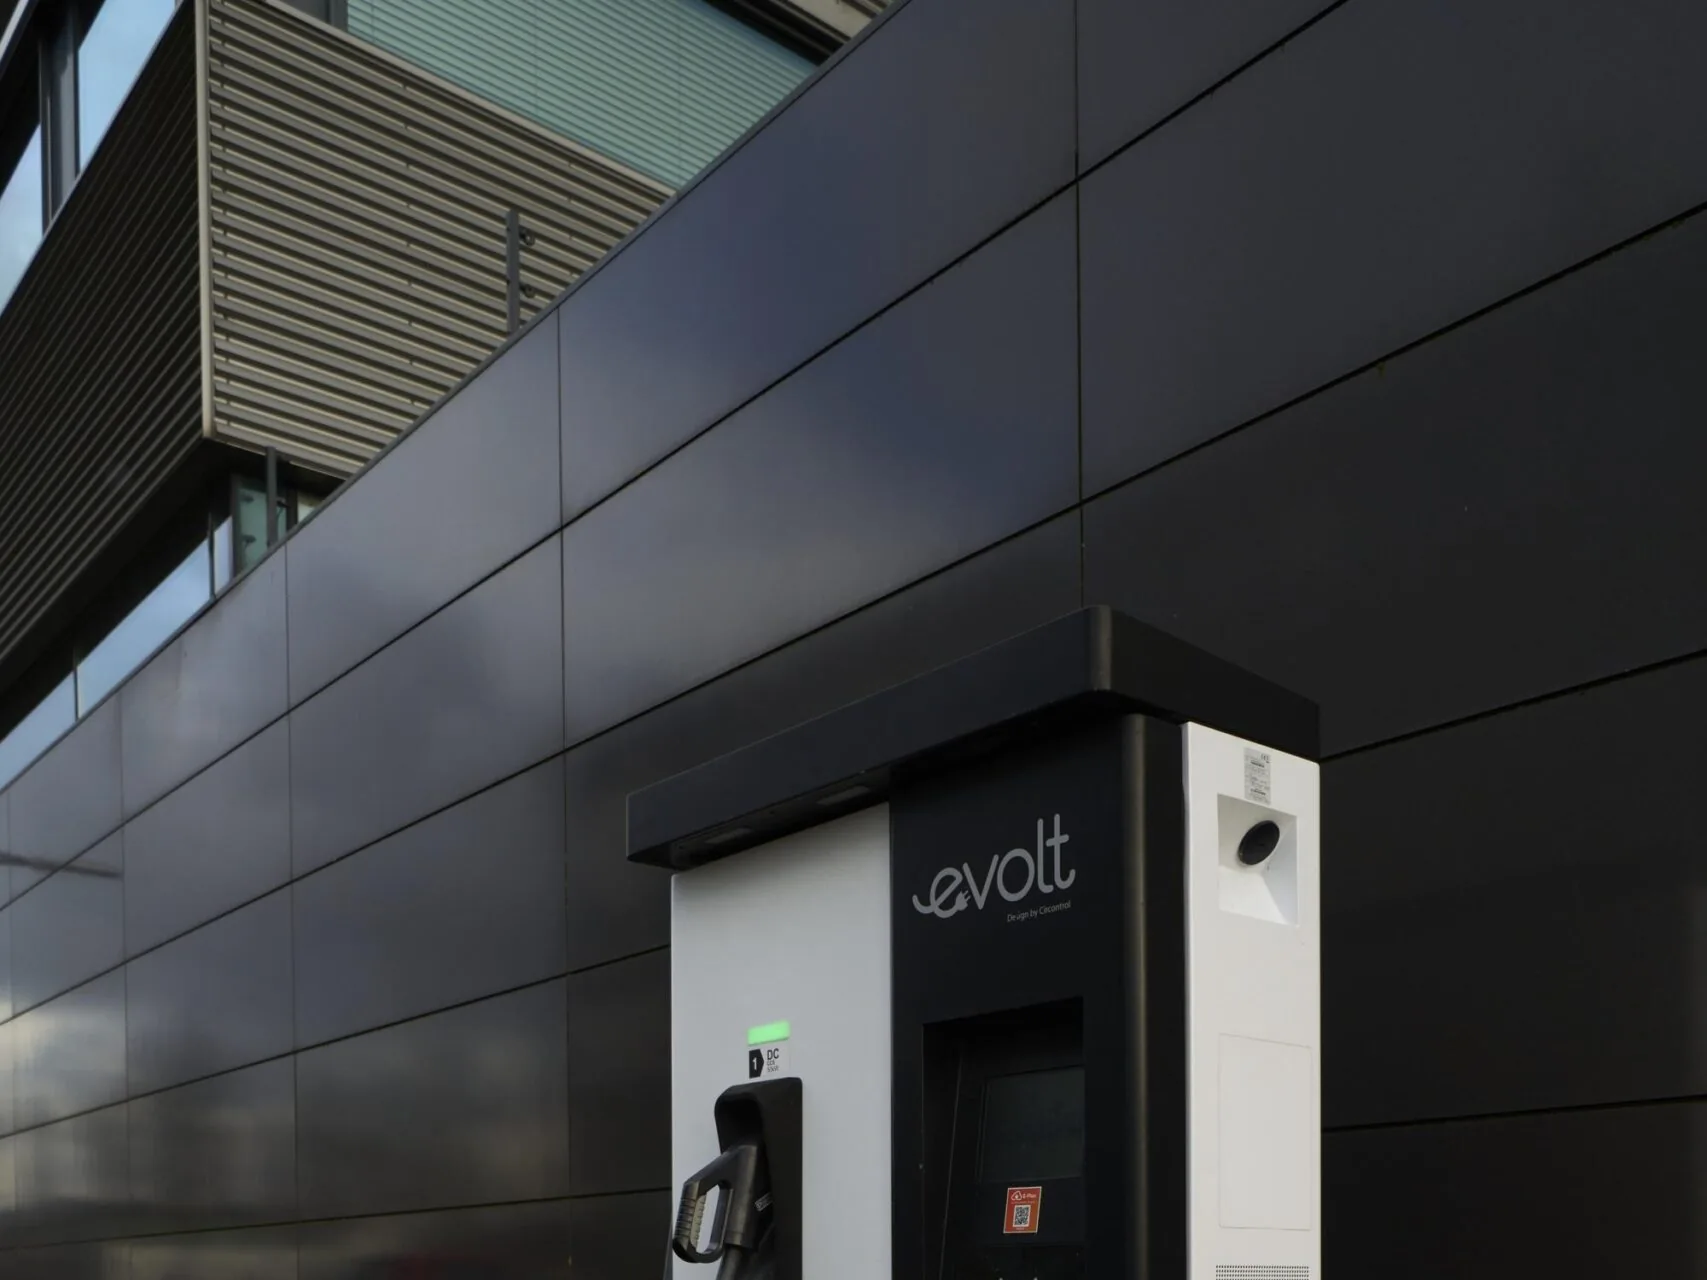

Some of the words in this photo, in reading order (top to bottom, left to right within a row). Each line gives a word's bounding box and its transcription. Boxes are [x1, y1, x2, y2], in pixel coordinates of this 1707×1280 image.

[912, 813, 1076, 919] evolt
[766, 1048, 779, 1060] DC
[752, 1057, 758, 1071] 1
